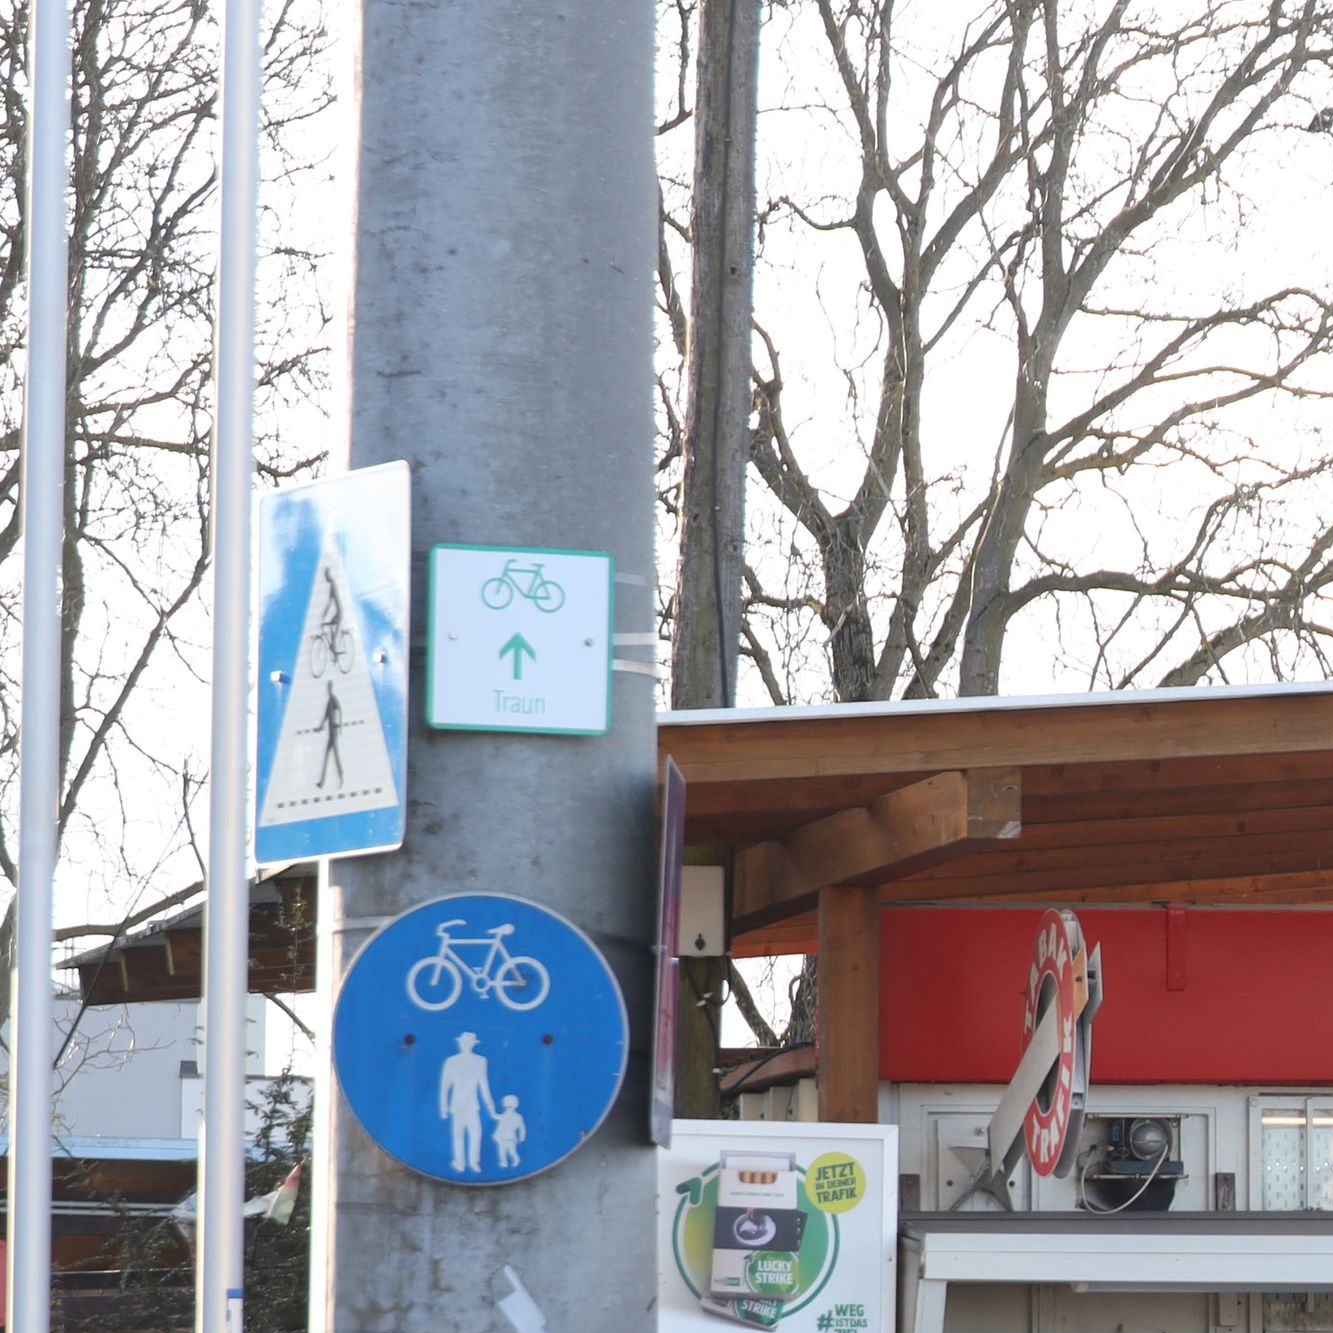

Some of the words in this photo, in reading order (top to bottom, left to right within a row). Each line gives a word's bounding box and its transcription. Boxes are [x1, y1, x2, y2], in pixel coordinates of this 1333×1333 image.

[493, 689, 546, 715] Traun
[1023, 921, 1068, 1035] TABAK
[1031, 1012, 1073, 1164] TRAFIK
[815, 1161, 856, 1181] JETZT
[815, 1186, 858, 1204] TRAFIK
[757, 1259, 793, 1272] LUCKY
[755, 1271, 794, 1285] STRIKE
[741, 1300, 778, 1319] STRIKE
